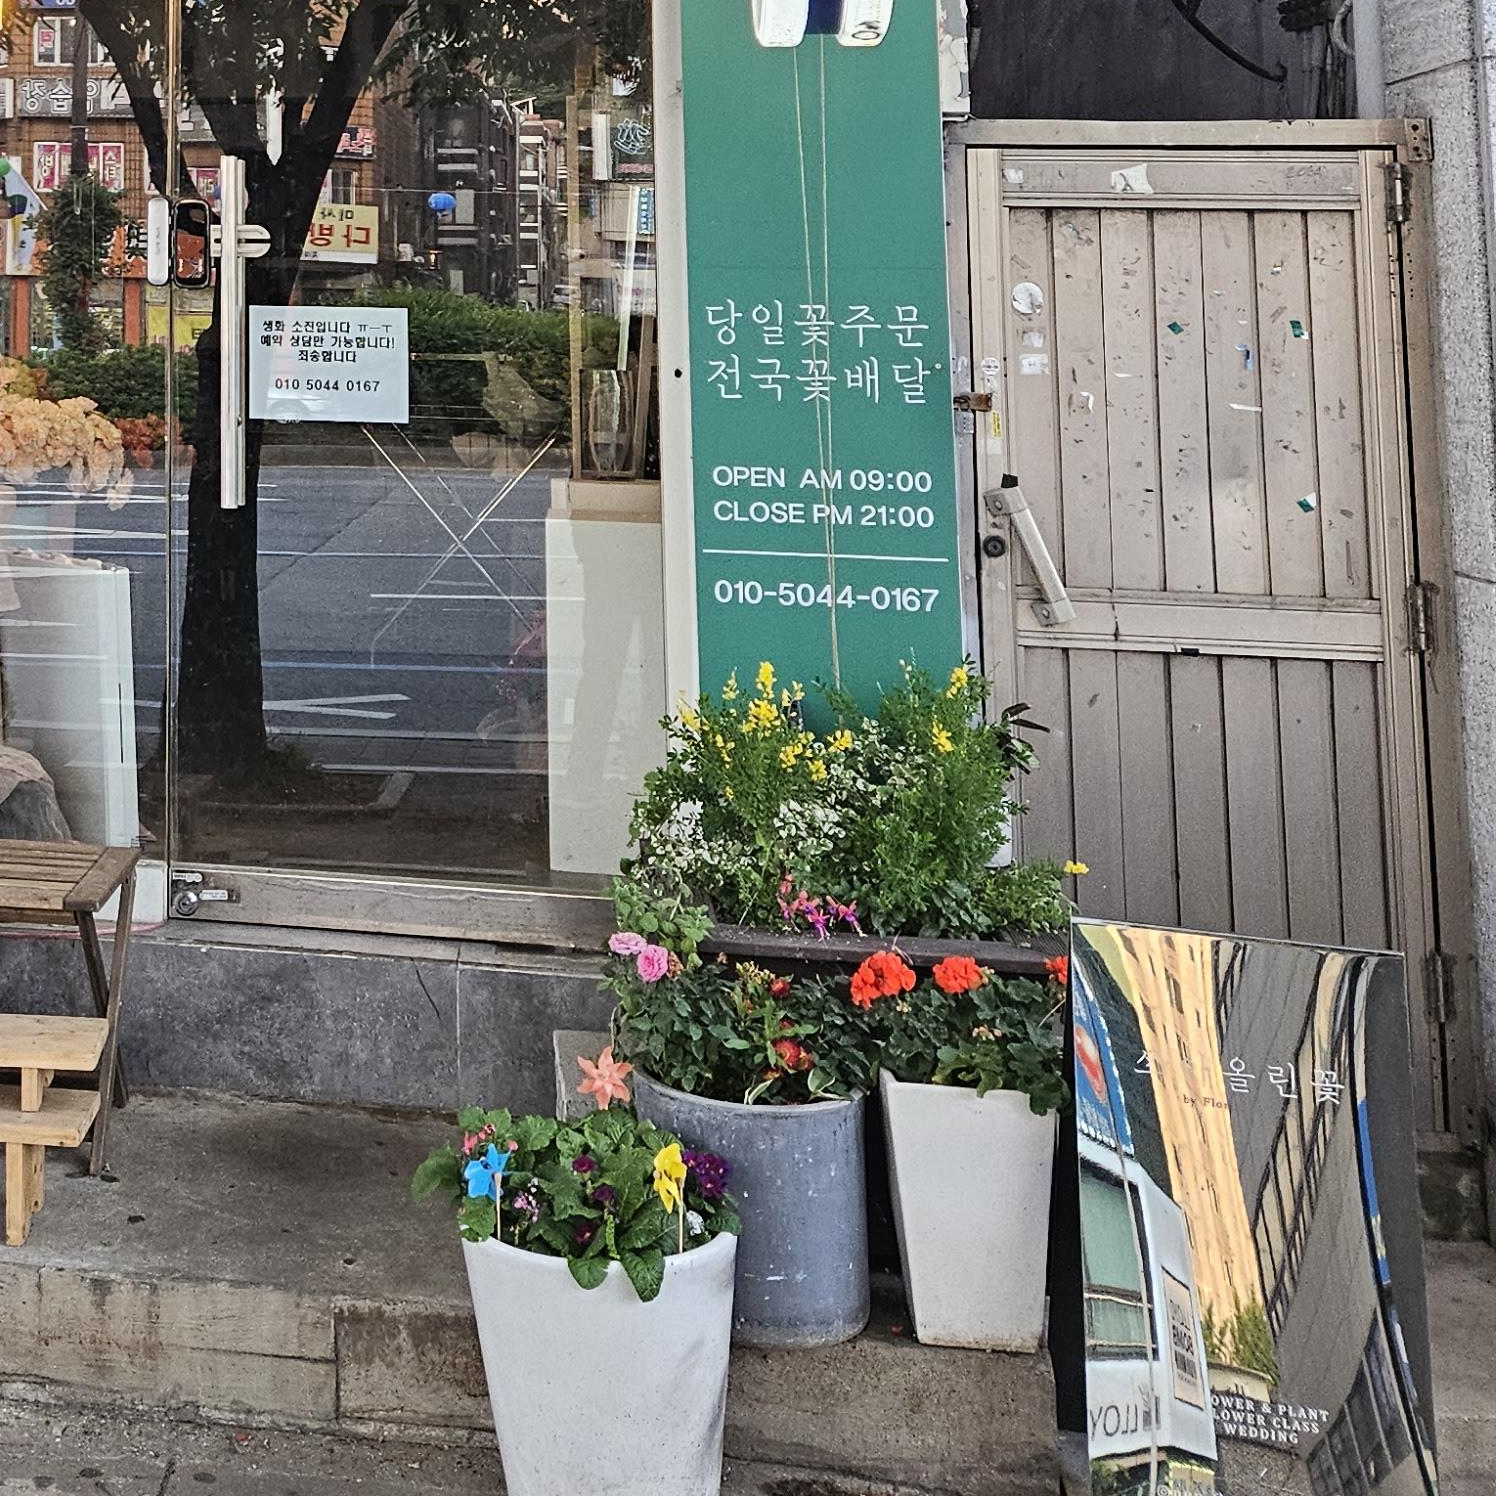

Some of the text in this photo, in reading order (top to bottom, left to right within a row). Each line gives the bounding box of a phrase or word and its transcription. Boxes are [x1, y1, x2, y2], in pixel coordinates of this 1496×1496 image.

[262, 320, 286, 332] 생화
[291, 321, 351, 334] 소진입니다
[705, 298, 930, 349] 당일꽃주문
[260, 334, 396, 350] 예약 상담만 가능합니다!
[297, 349, 357, 363] 죄송합니다
[275, 377, 381, 393] 010 5044 0167
[706, 352, 933, 405] 전국꽃배달
[712, 465, 933, 493] OPEN AM 09:00
[713, 500, 935, 529] CLOSE PM 21:00
[714, 580, 940, 613] 010-5044-0167
[1210, 1394, 1330, 1423] OWER & PLANT
[1223, 1422, 1300, 1445] WEDDING
[1272, 1415, 1321, 1435] CLASS
